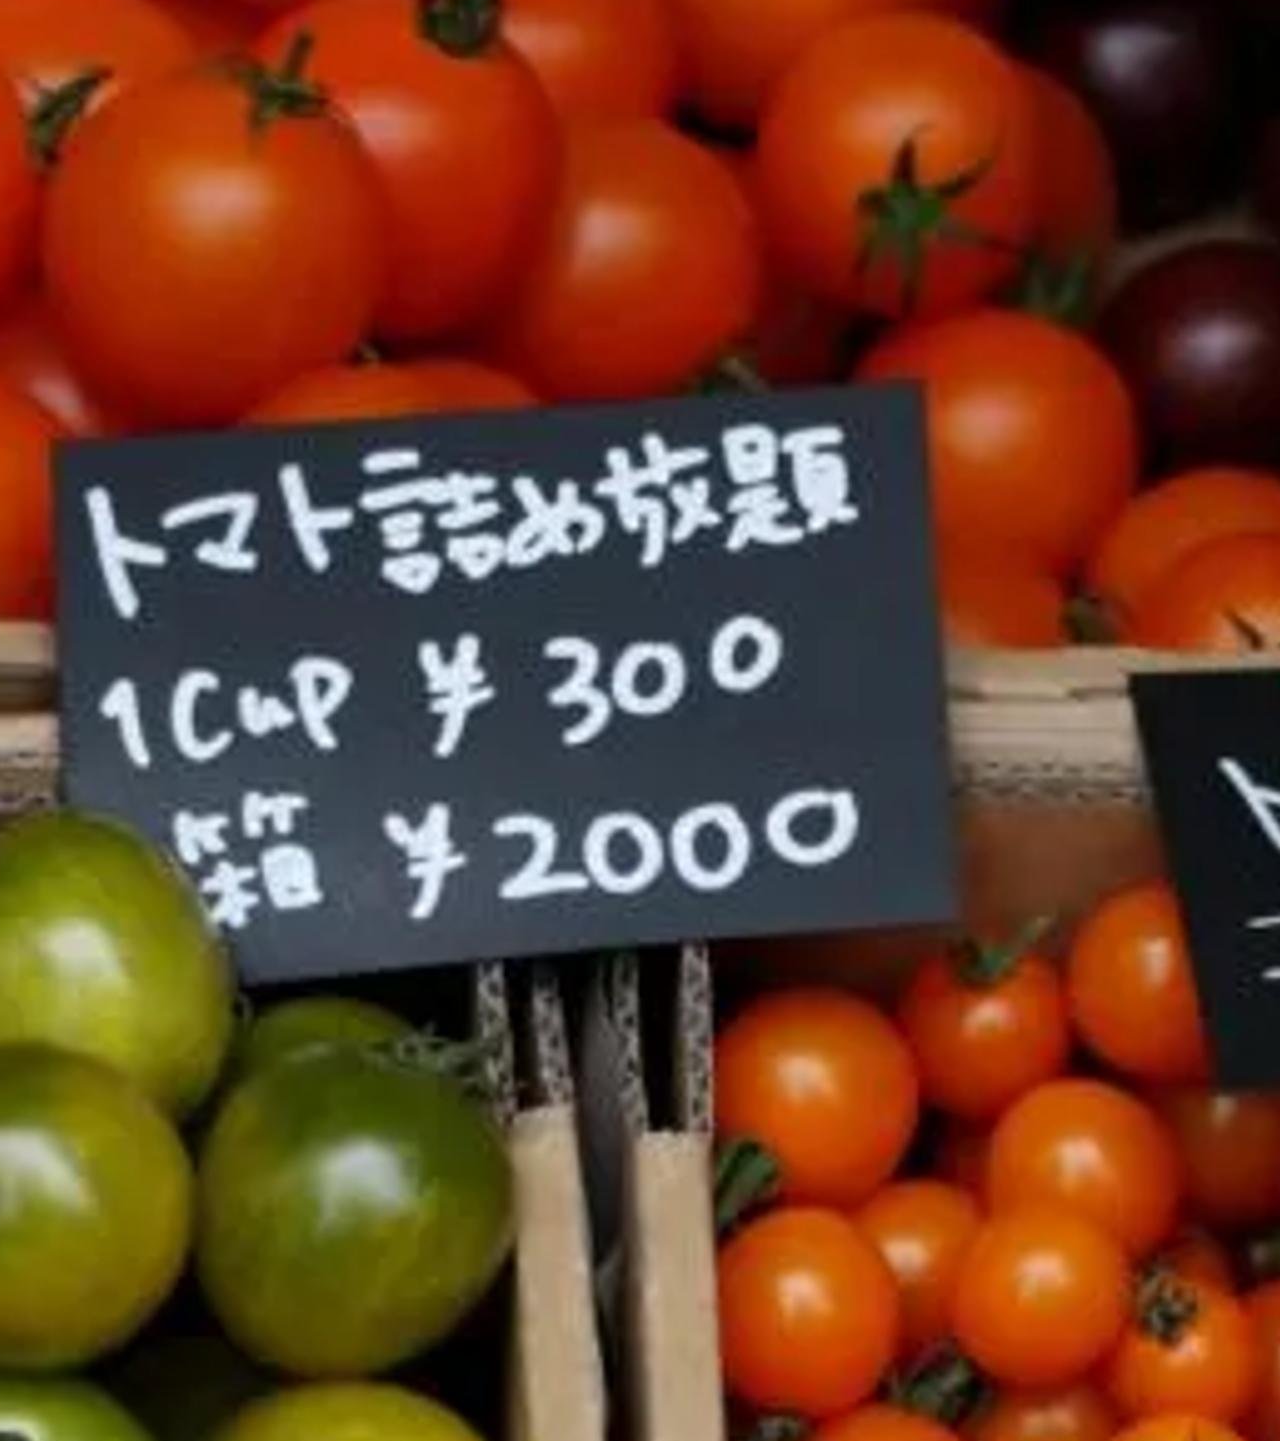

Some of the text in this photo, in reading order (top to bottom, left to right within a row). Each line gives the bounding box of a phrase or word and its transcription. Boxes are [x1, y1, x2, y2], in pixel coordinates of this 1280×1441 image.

[85, 422, 860, 620] トマト詰め放題
[173, 787, 860, 928] 箱 ¥2000
